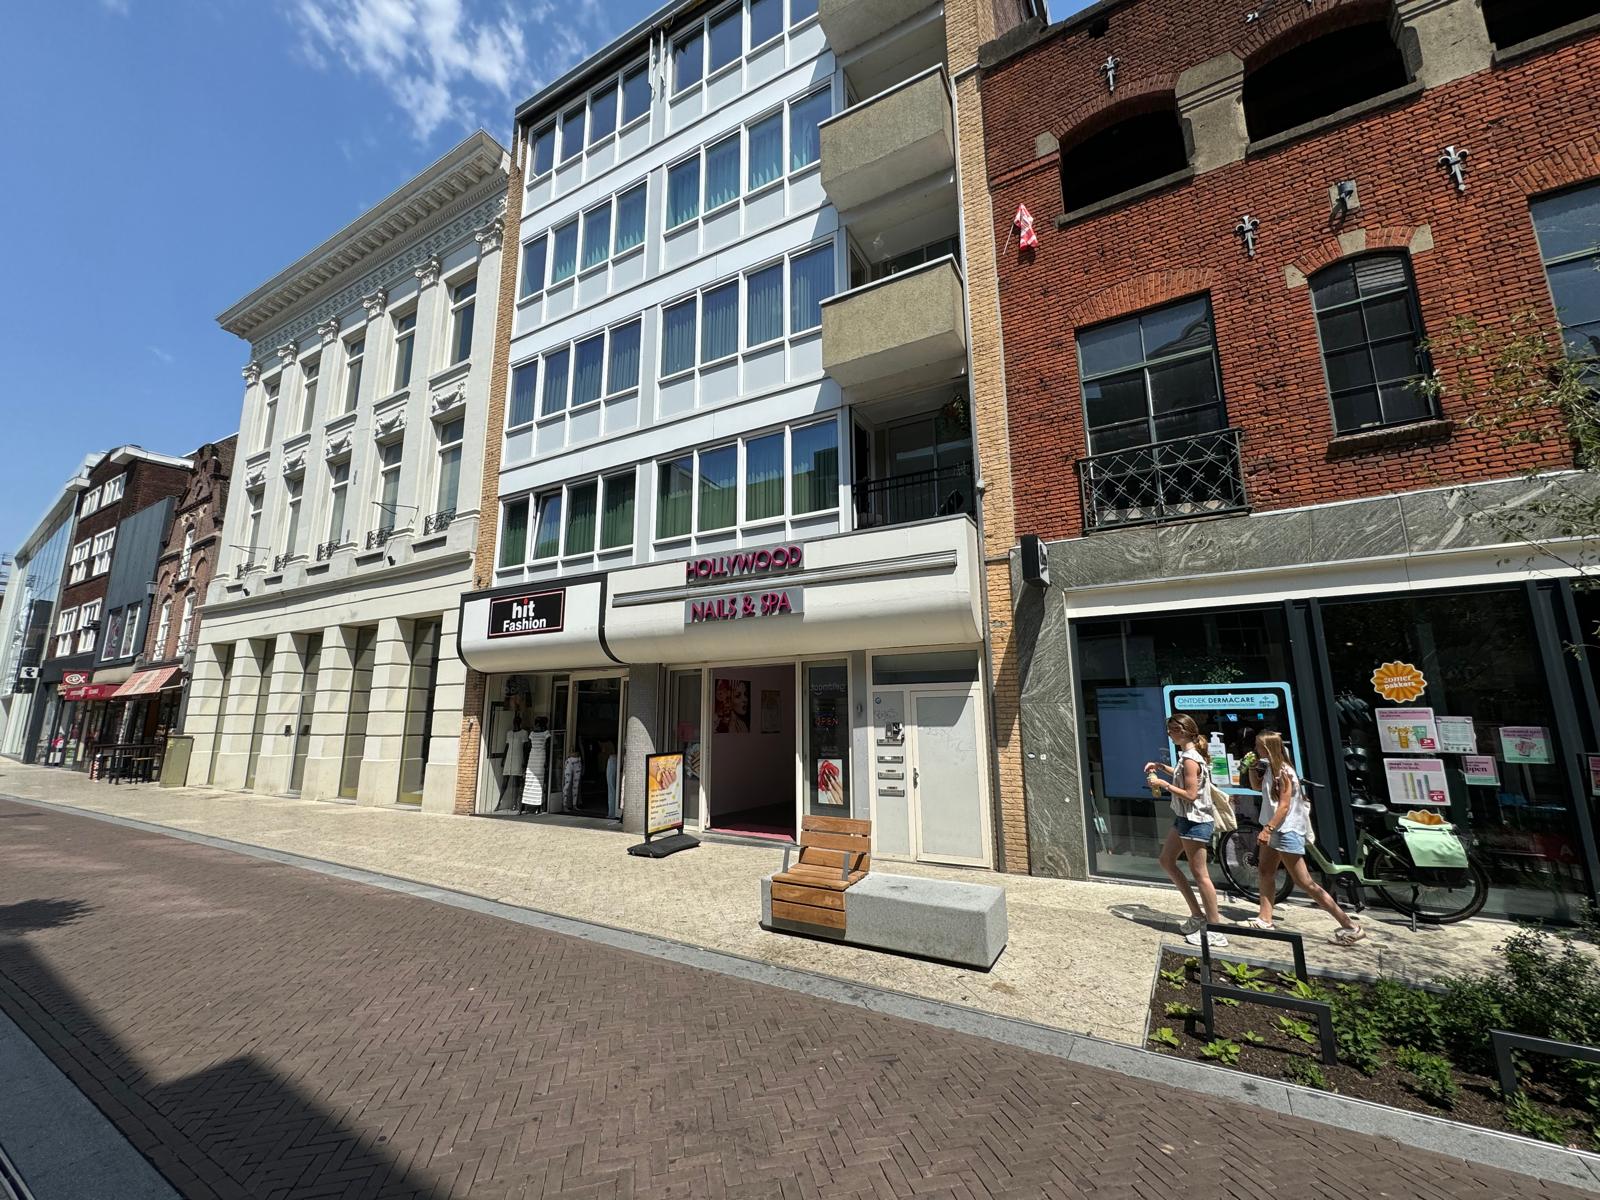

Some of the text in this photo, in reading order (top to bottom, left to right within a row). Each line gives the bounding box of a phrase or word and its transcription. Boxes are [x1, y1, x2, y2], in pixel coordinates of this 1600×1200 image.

[686, 545, 802, 577] HOLLYWOOD
[512, 597, 536, 619] hit
[691, 591, 792, 623] NAILS & SPA
[503, 617, 547, 632] Fashion
[1177, 697, 1206, 705] ONTDEK
[1208, 696, 1255, 704] DERMACARE
